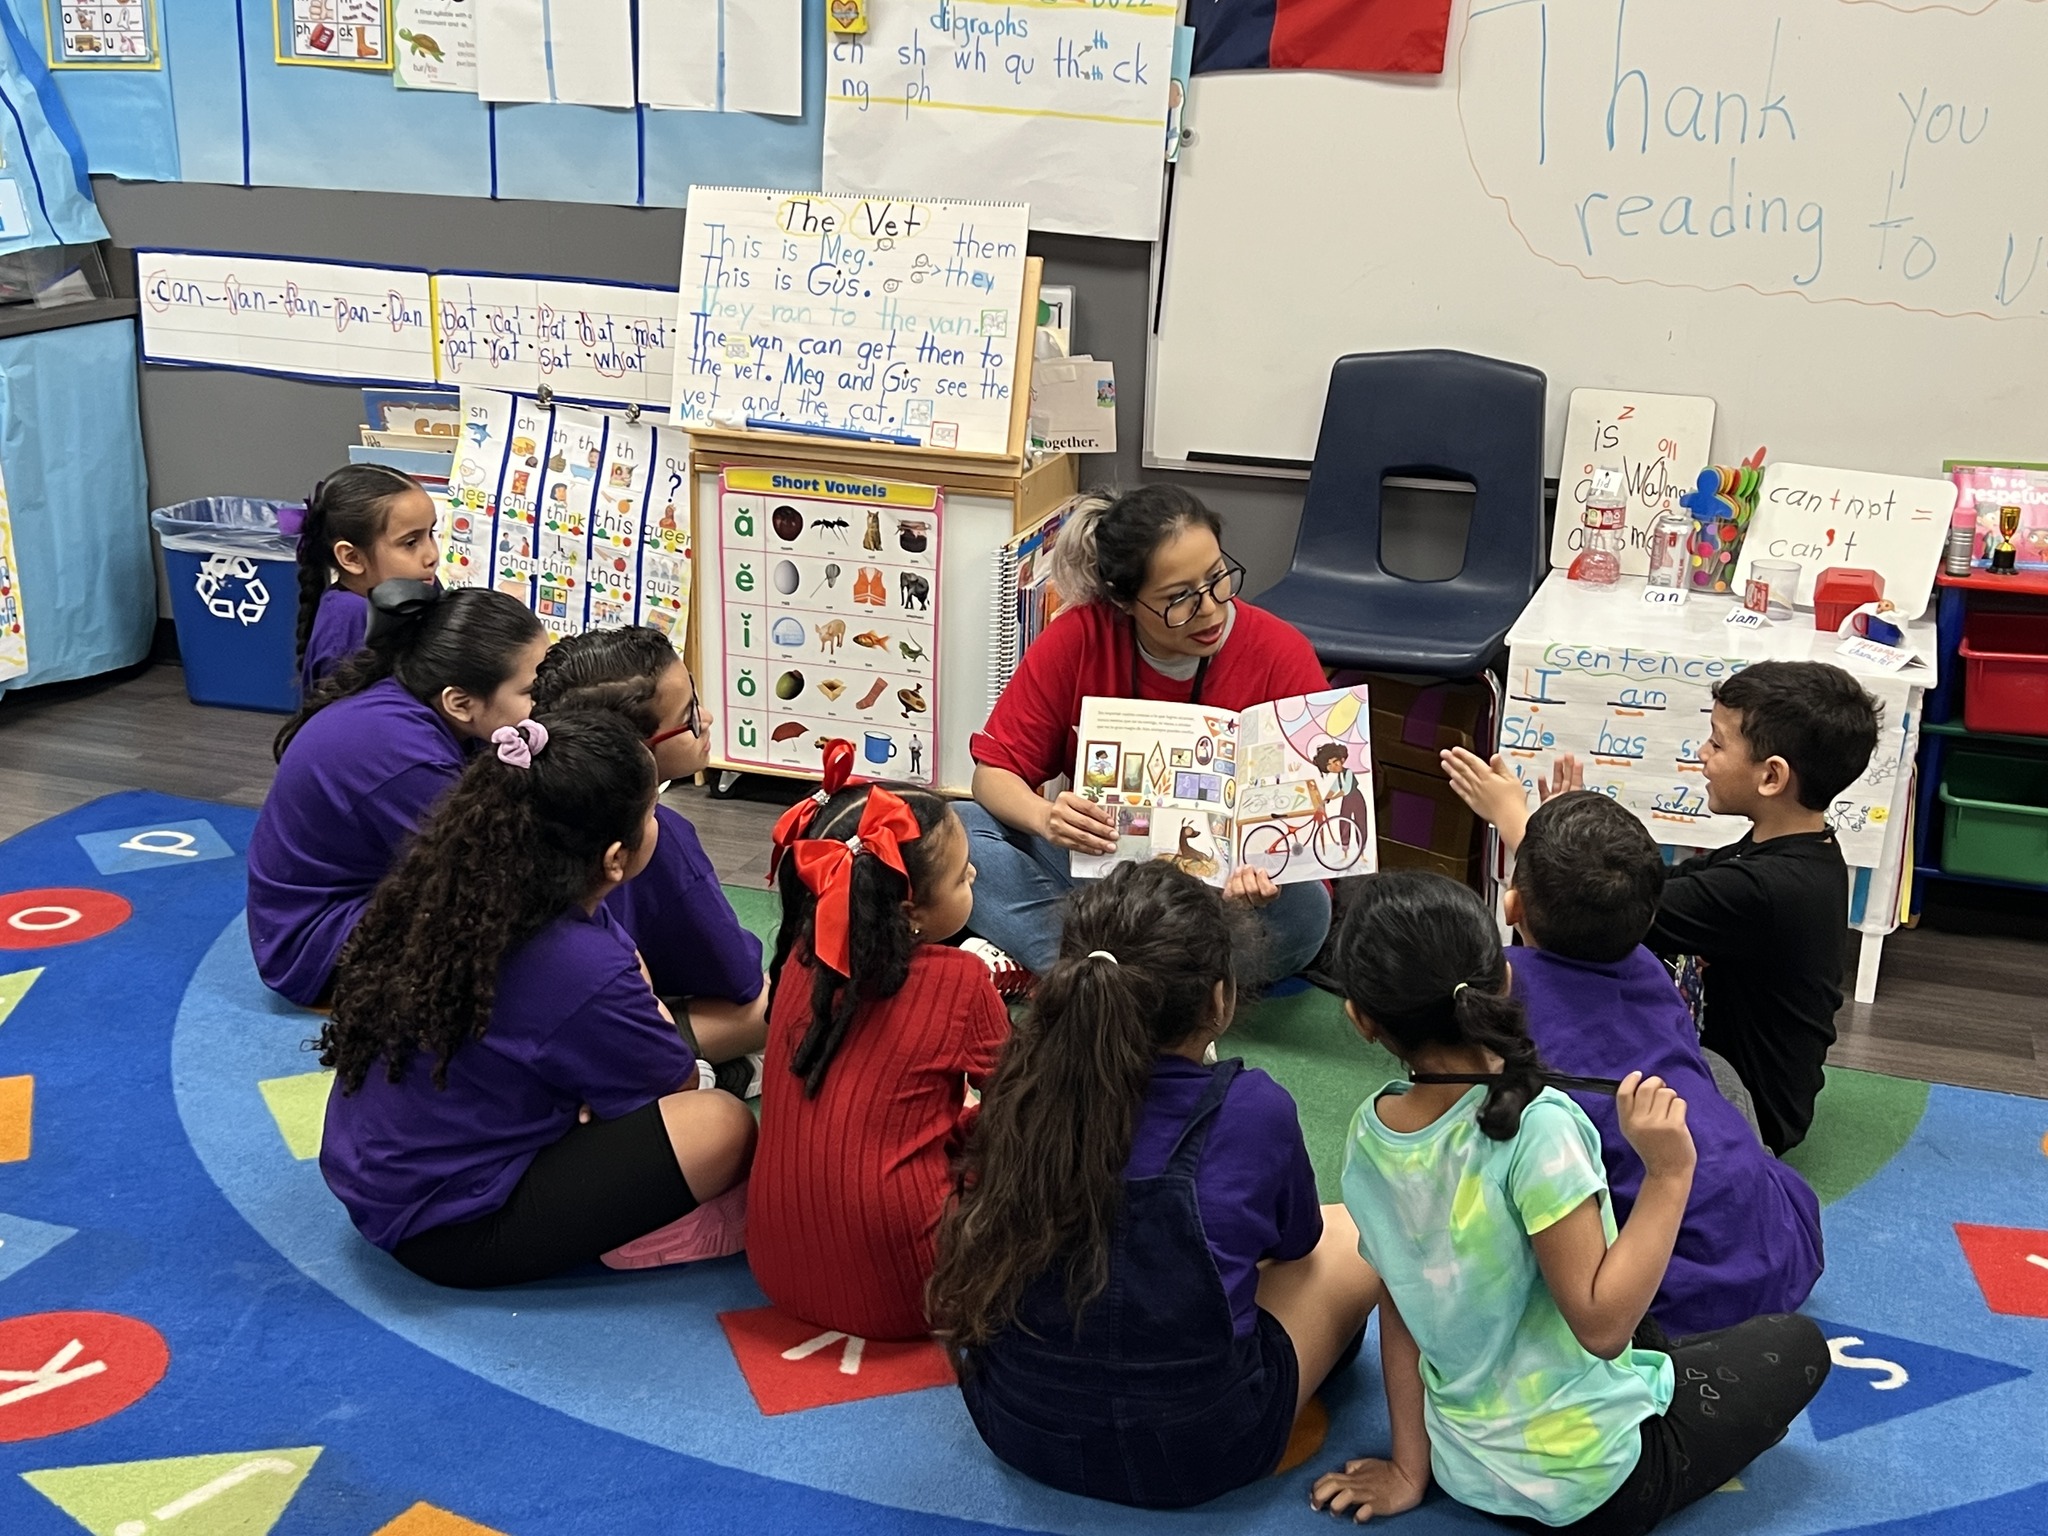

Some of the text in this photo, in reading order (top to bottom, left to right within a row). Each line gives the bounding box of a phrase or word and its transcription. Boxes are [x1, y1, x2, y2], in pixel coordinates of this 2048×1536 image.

[296, 23, 311, 37] ph
[339, 25, 353, 37] ck
[930, 0, 1028, 47] digraphs
[833, 28, 1148, 86] ch sh wh qu th th ck
[842, 69, 931, 121] ng ph
[1468, 0, 1989, 190] Thank you
[786, 200, 921, 237] The Vet
[1575, 156, 1823, 287] reading
[1869, 170, 1937, 281] to
[704, 223, 874, 275] This is Meg.
[953, 222, 1016, 259] them
[700, 255, 871, 298] This is Gus.
[945, 256, 995, 295] they
[442, 283, 477, 331] bat
[581, 312, 614, 342] hat
[633, 317, 666, 348] mat
[697, 285, 979, 336] They ran to the van.
[448, 331, 477, 370] pat
[490, 332, 520, 366] rat
[595, 341, 646, 372] what
[690, 312, 1003, 370] The van can get then to
[688, 347, 1009, 400] the vet. Meg and Gus see the
[683, 374, 895, 425] vet and the cat.
[518, 417, 535, 431] ch
[1594, 420, 1619, 452] is
[553, 429, 594, 451] th th
[616, 441, 634, 460] th
[1044, 436, 1099, 451] ogether.
[665, 458, 686, 474] qu
[447, 484, 497, 506] sheep
[772, 475, 887, 498] Short Vowels
[503, 494, 537, 515] chip
[547, 506, 586, 528] think
[593, 509, 633, 535] this
[1769, 528, 1857, 561] can't
[500, 554, 536, 574] chat
[542, 558, 573, 576] thin
[591, 566, 632, 590] that
[646, 577, 680, 600] quiz
[1644, 590, 1679, 603] can
[540, 617, 578, 636] math
[1726, 610, 1758, 625] jam
[1619, 688, 1667, 706] am
[1502, 716, 1555, 747] She
[1597, 719, 1647, 755] has
